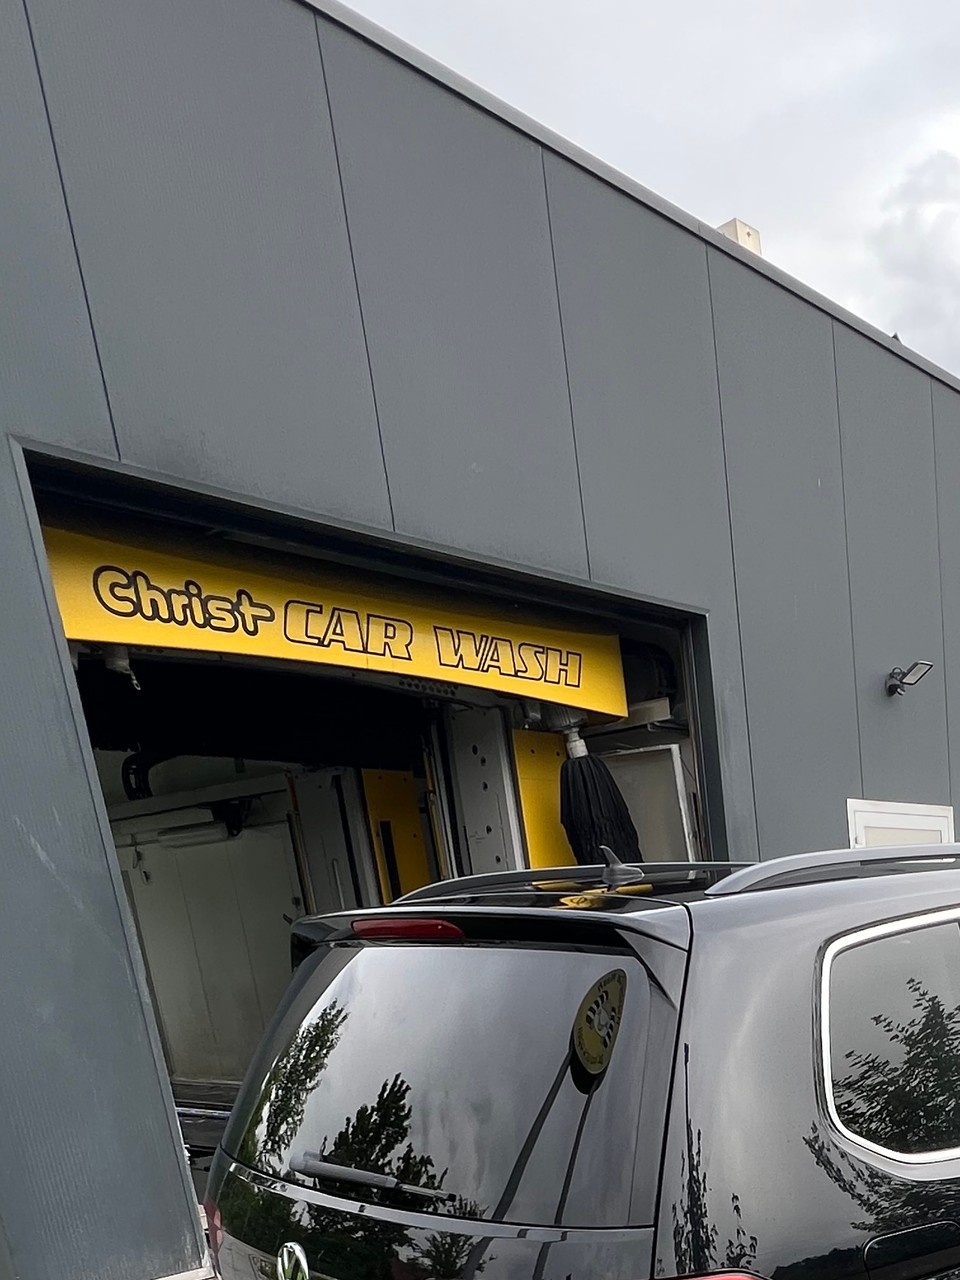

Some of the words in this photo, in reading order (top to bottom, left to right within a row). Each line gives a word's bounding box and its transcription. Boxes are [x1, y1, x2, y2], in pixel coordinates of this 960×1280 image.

[92, 564, 275, 637] Christ
[283, 600, 412, 661] CAR
[433, 625, 581, 688] WASH
